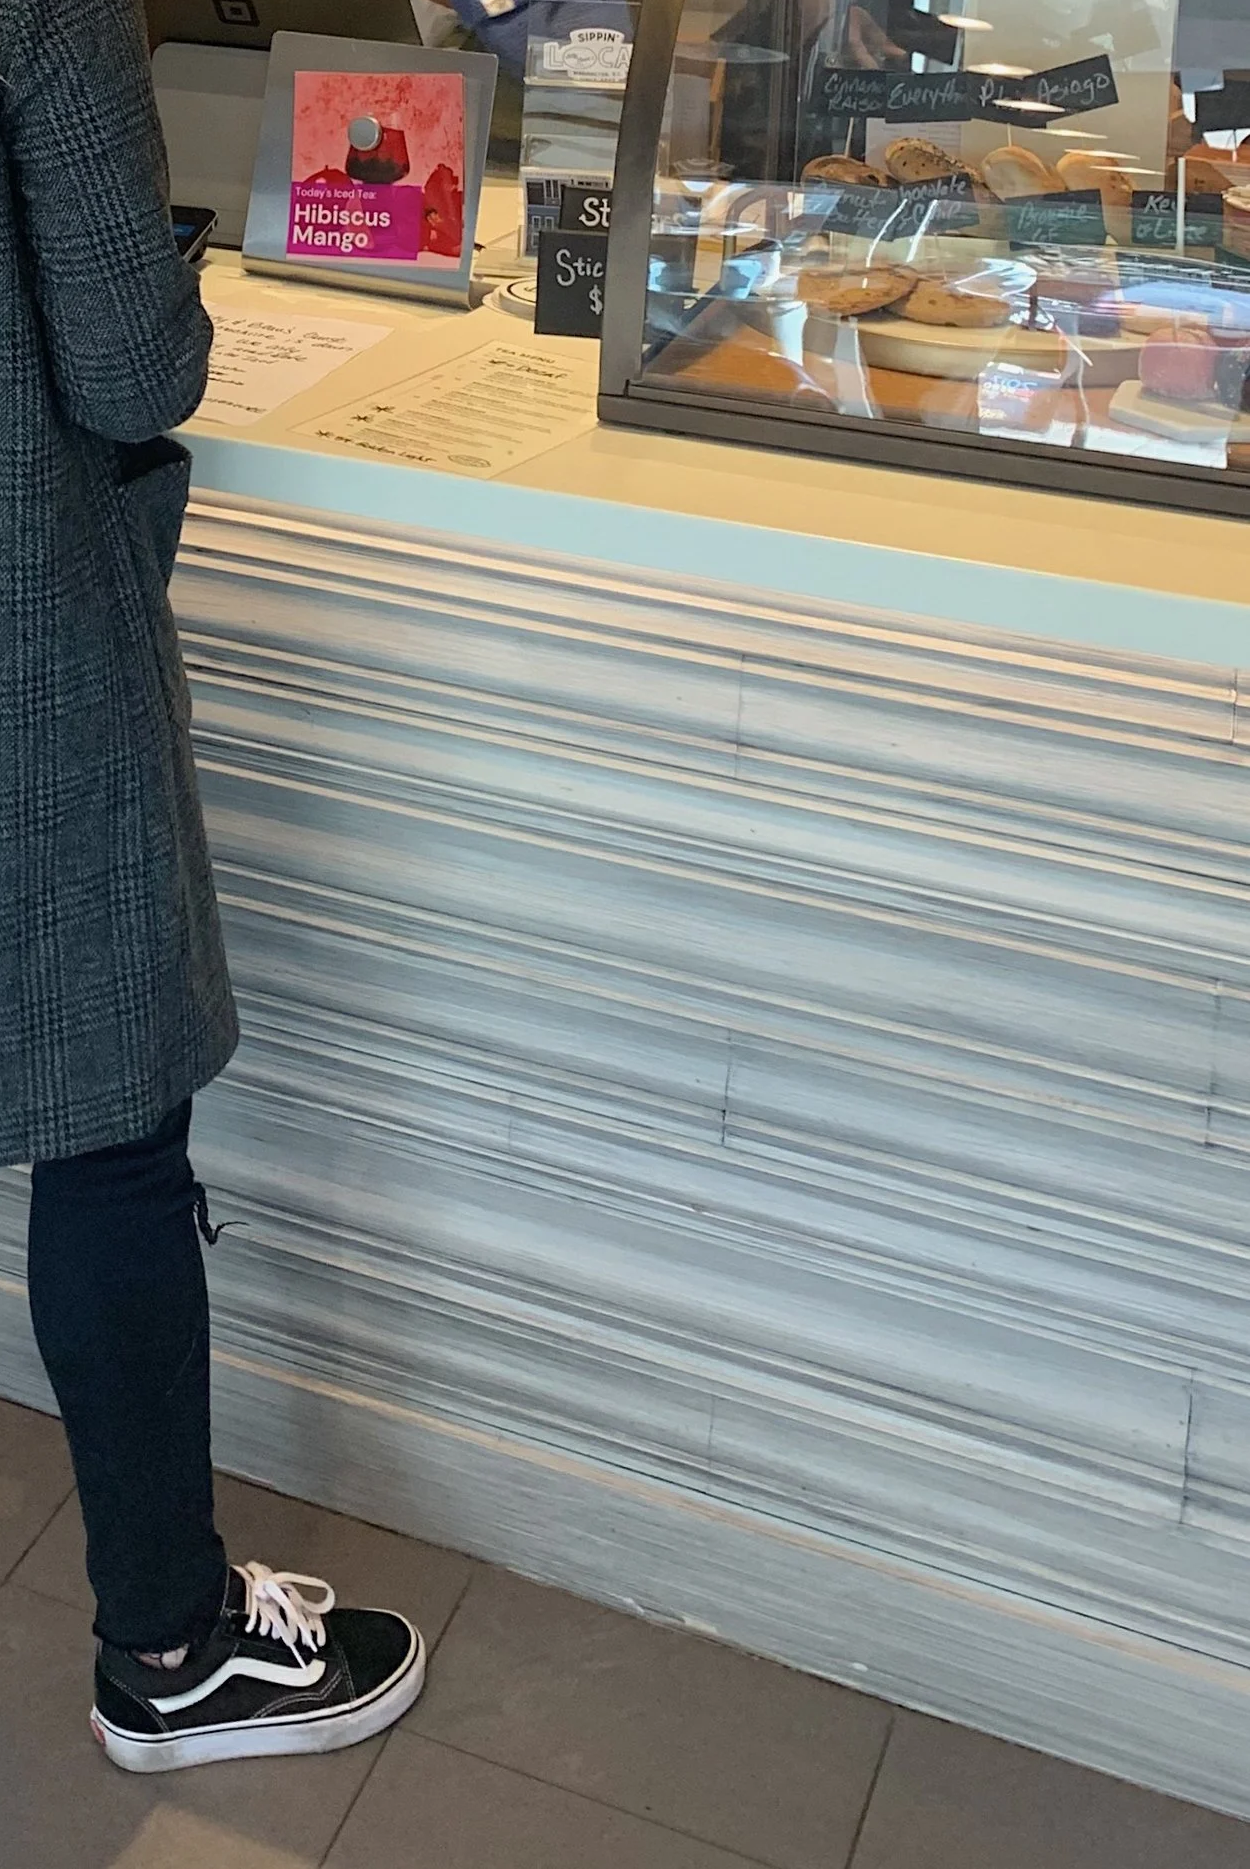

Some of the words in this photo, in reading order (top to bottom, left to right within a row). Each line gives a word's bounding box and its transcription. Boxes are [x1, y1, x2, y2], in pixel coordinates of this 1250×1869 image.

[1037, 73, 1110, 106] Asiago
[295, 185, 332, 201] Today's
[333, 187, 355, 200] Iced
[355, 188, 377, 200] Tea:
[294, 203, 391, 228] Hibiscus
[292, 224, 369, 251] Mango
[556, 249, 604, 286] Stic
